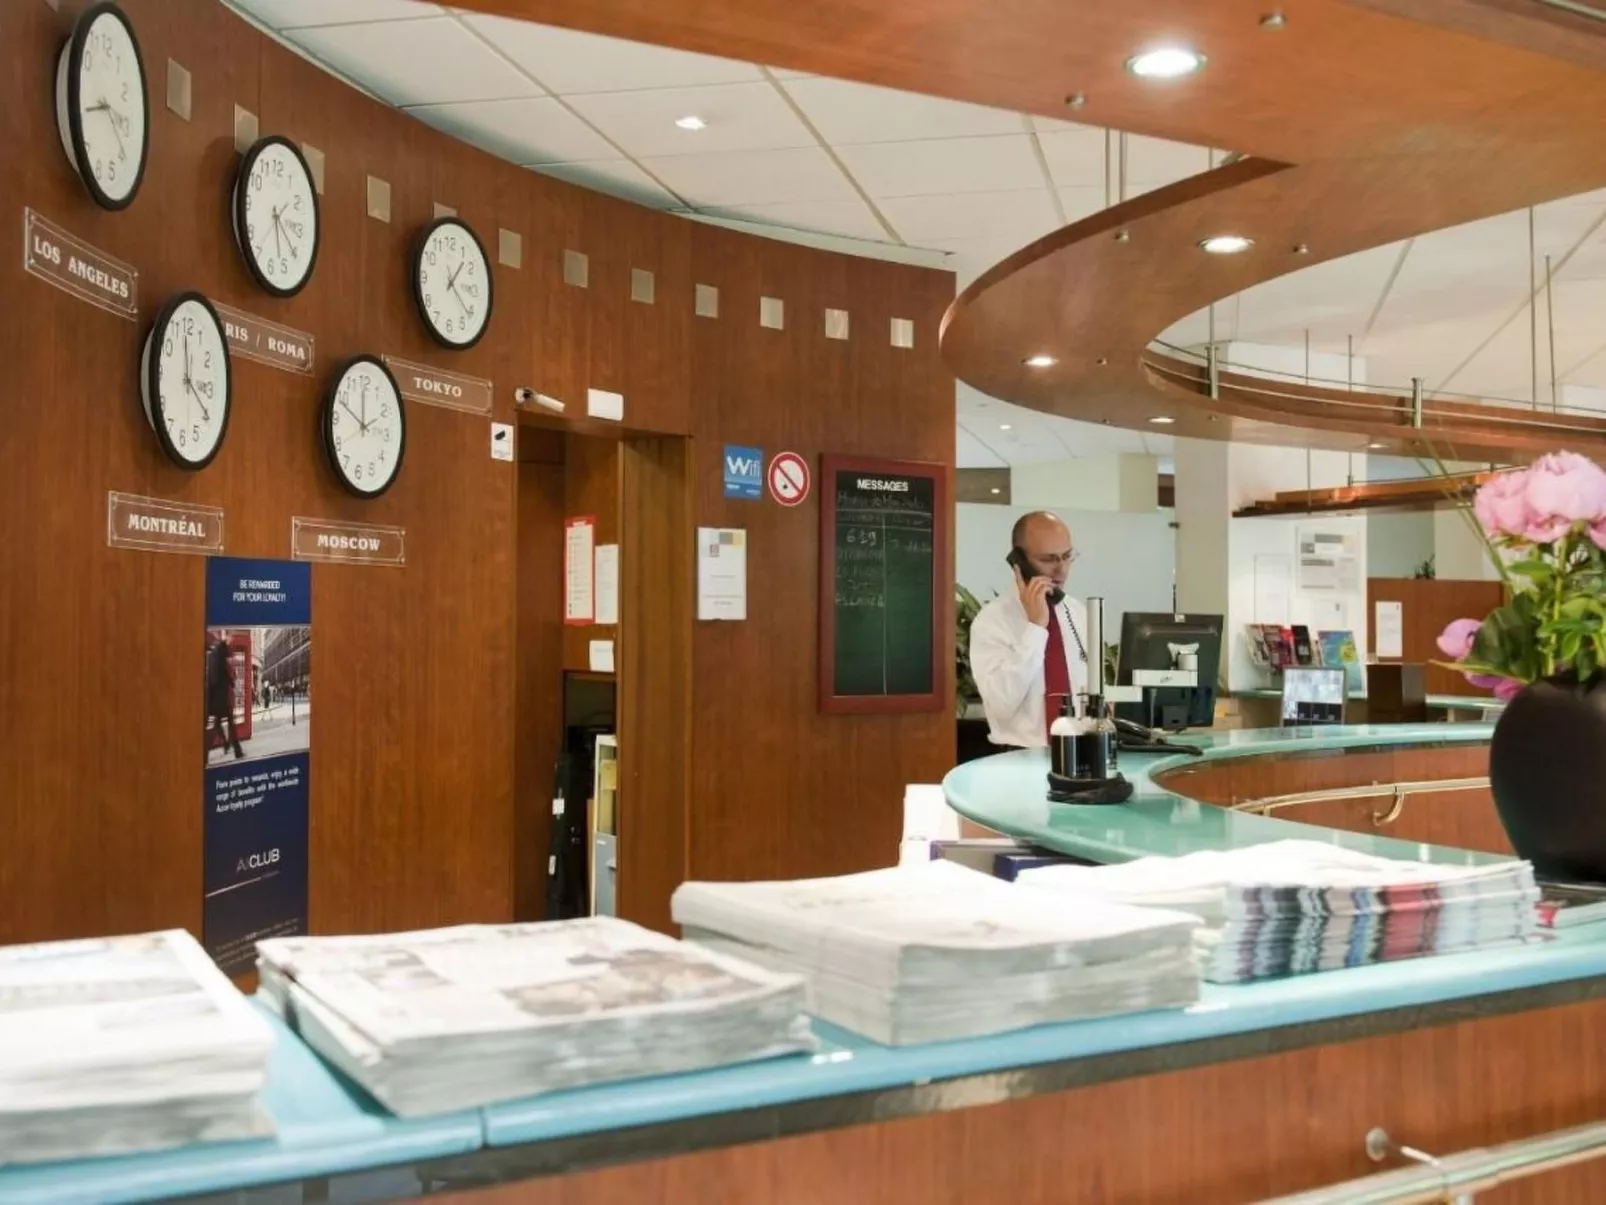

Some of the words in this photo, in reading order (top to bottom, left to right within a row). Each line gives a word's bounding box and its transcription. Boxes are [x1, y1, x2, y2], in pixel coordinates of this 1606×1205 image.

[272, 159, 284, 178] 12
[34, 235, 61, 265] LOS
[68, 255, 129, 298] ANGELES
[182, 316, 193, 336] 12
[267, 336, 306, 361] ROMA
[412, 376, 463, 398] TOKYO
[856, 478, 910, 492] MESSAGES
[128, 513, 207, 538] MONTRÉAL
[317, 533, 382, 551] MOSCOW
